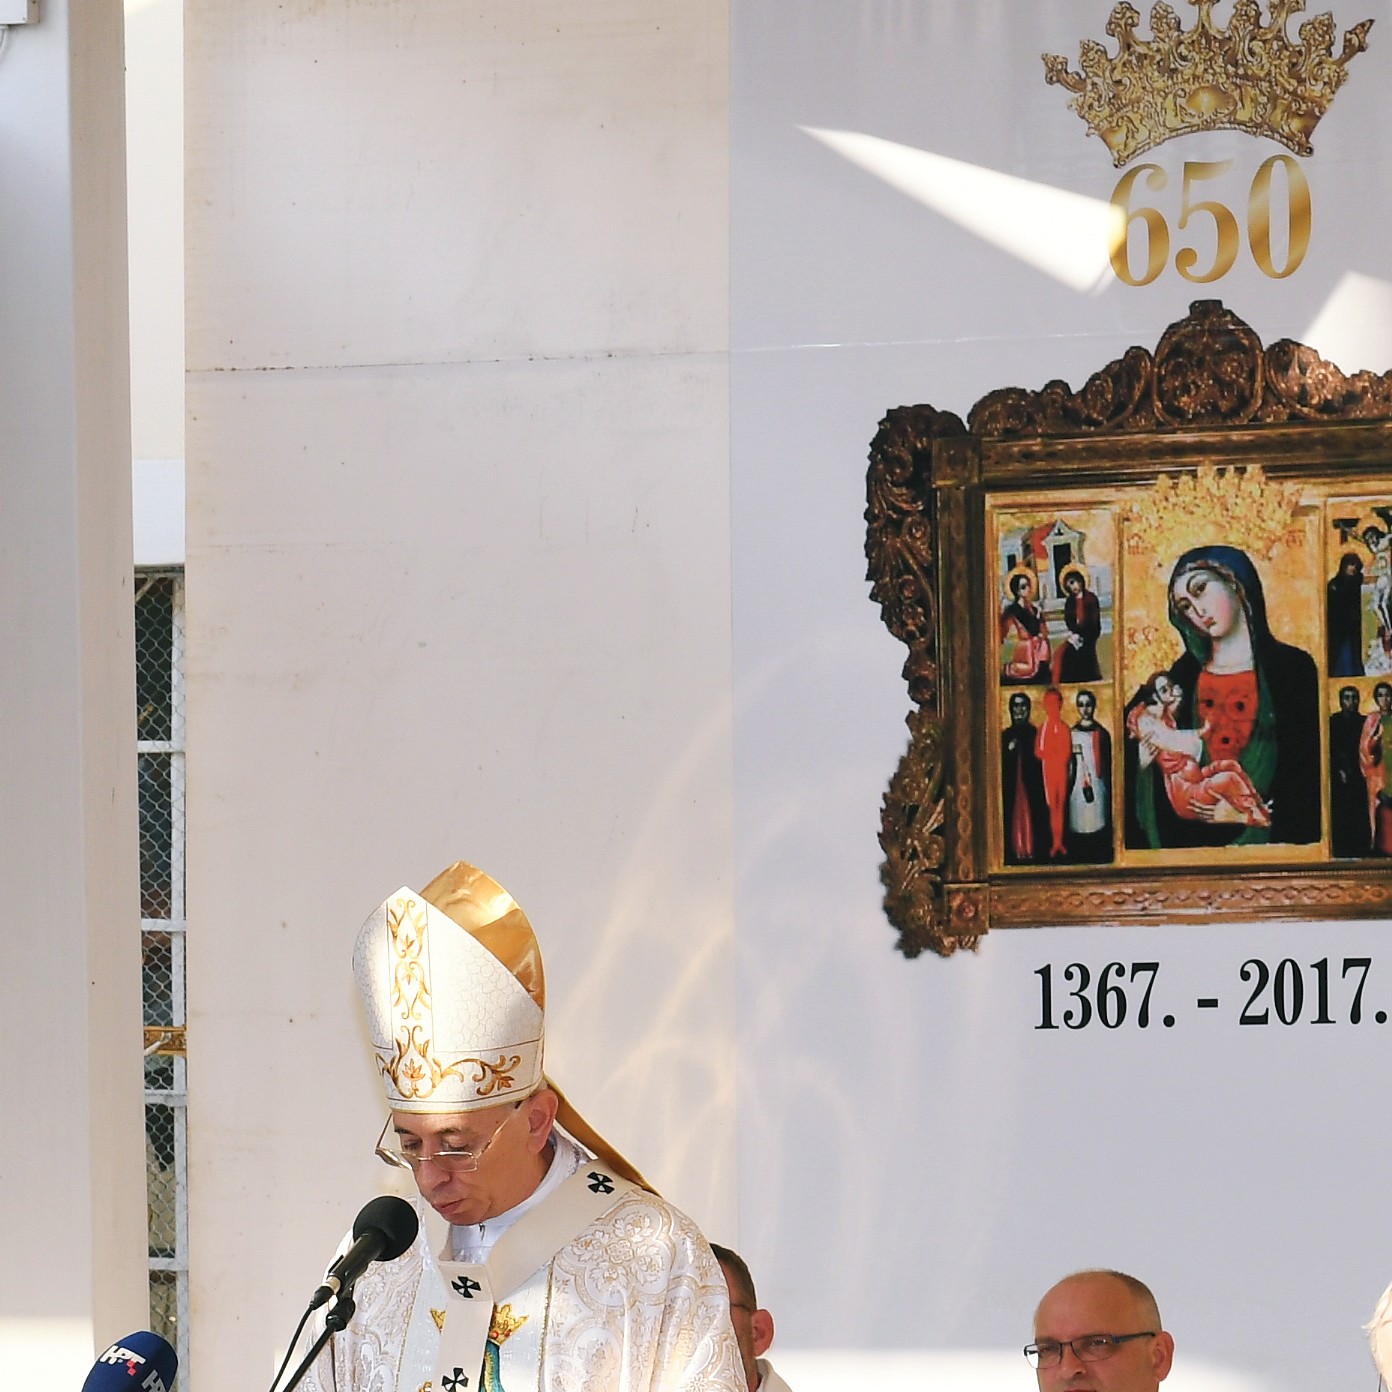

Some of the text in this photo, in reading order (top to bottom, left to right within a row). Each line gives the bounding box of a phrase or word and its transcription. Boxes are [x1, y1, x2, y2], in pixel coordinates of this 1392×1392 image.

[1109, 154, 1312, 286] 650
[1034, 962, 1176, 1029] 1367.
[1239, 957, 1388, 1026] 2017.
[99, 1345, 146, 1376] HRT
